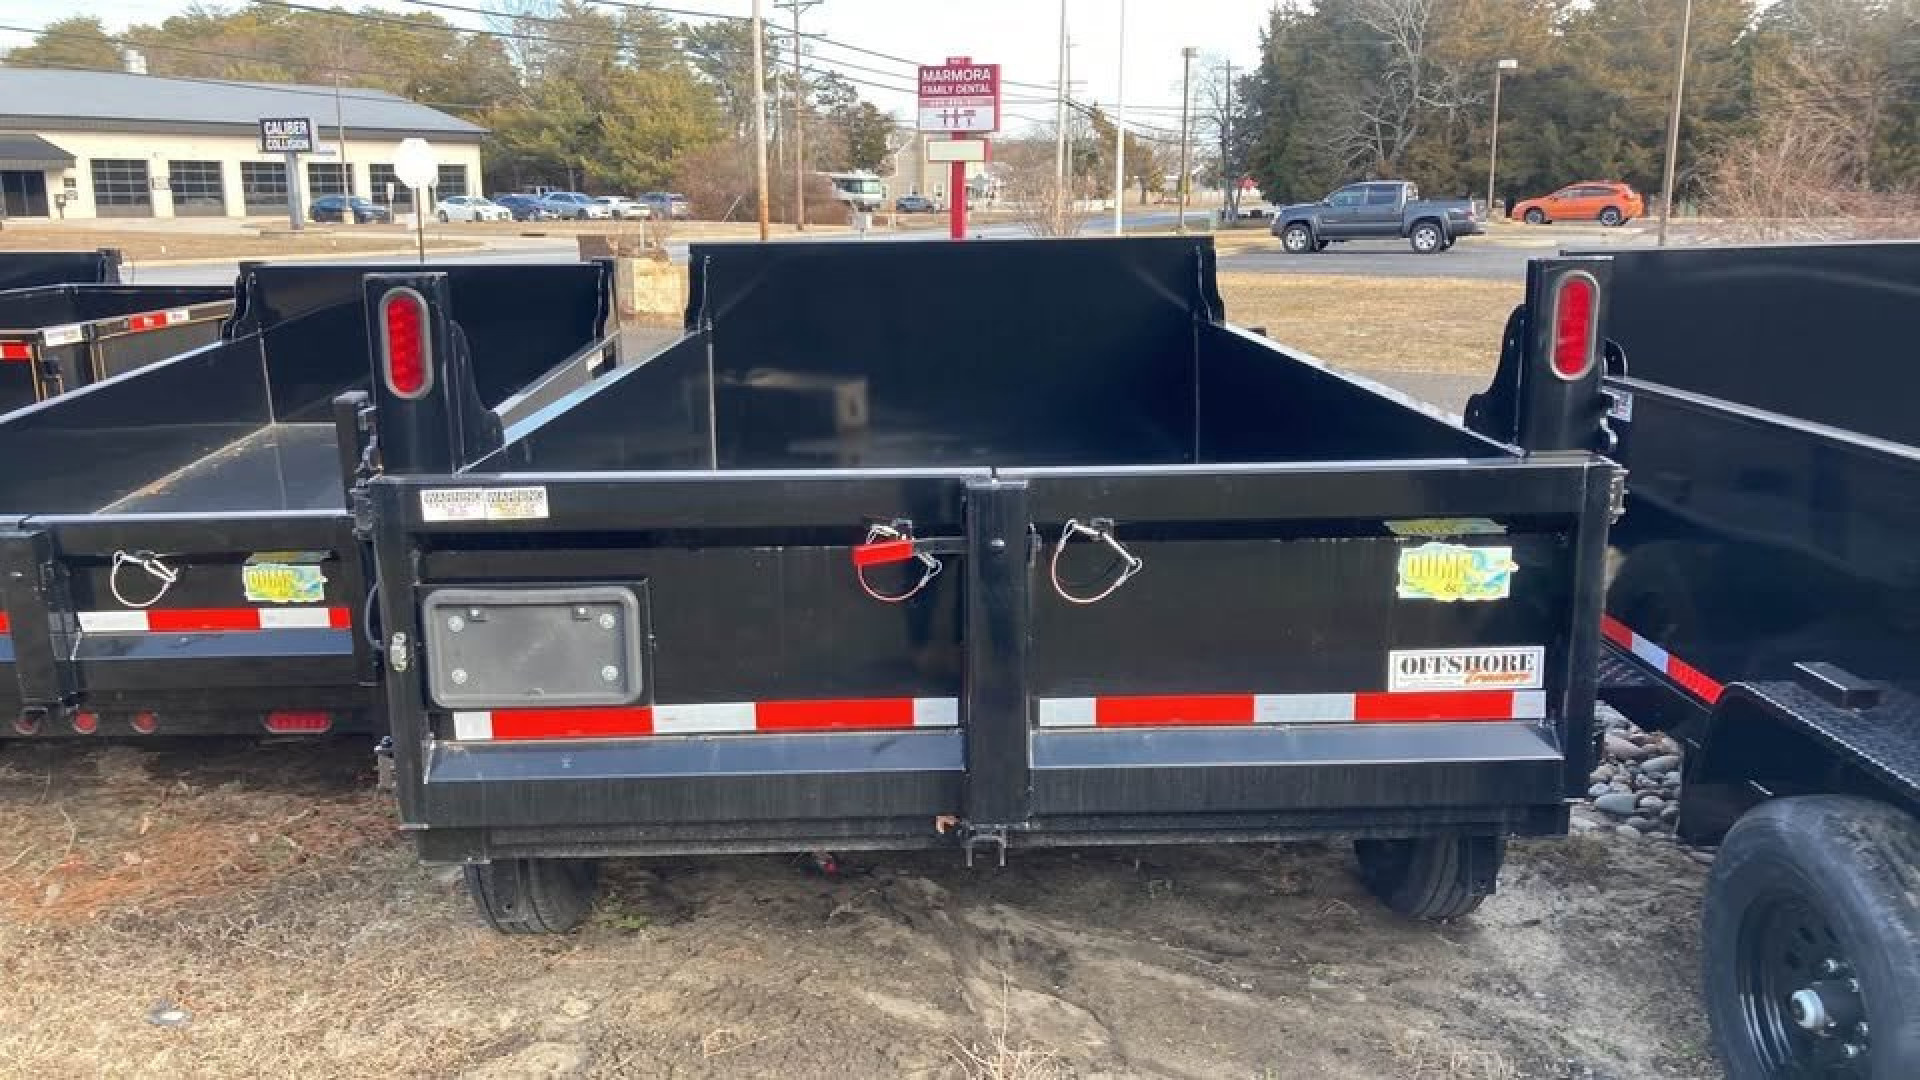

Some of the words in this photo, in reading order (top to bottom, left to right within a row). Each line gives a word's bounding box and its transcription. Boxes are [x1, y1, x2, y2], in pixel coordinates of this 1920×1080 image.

[922, 68, 991, 82] MARMORA
[921, 84, 954, 95] FAMILY
[956, 83, 992, 94] DENTAL
[264, 121, 307, 134] CALIBER
[1401, 654, 1535, 674] OFFSHORE
